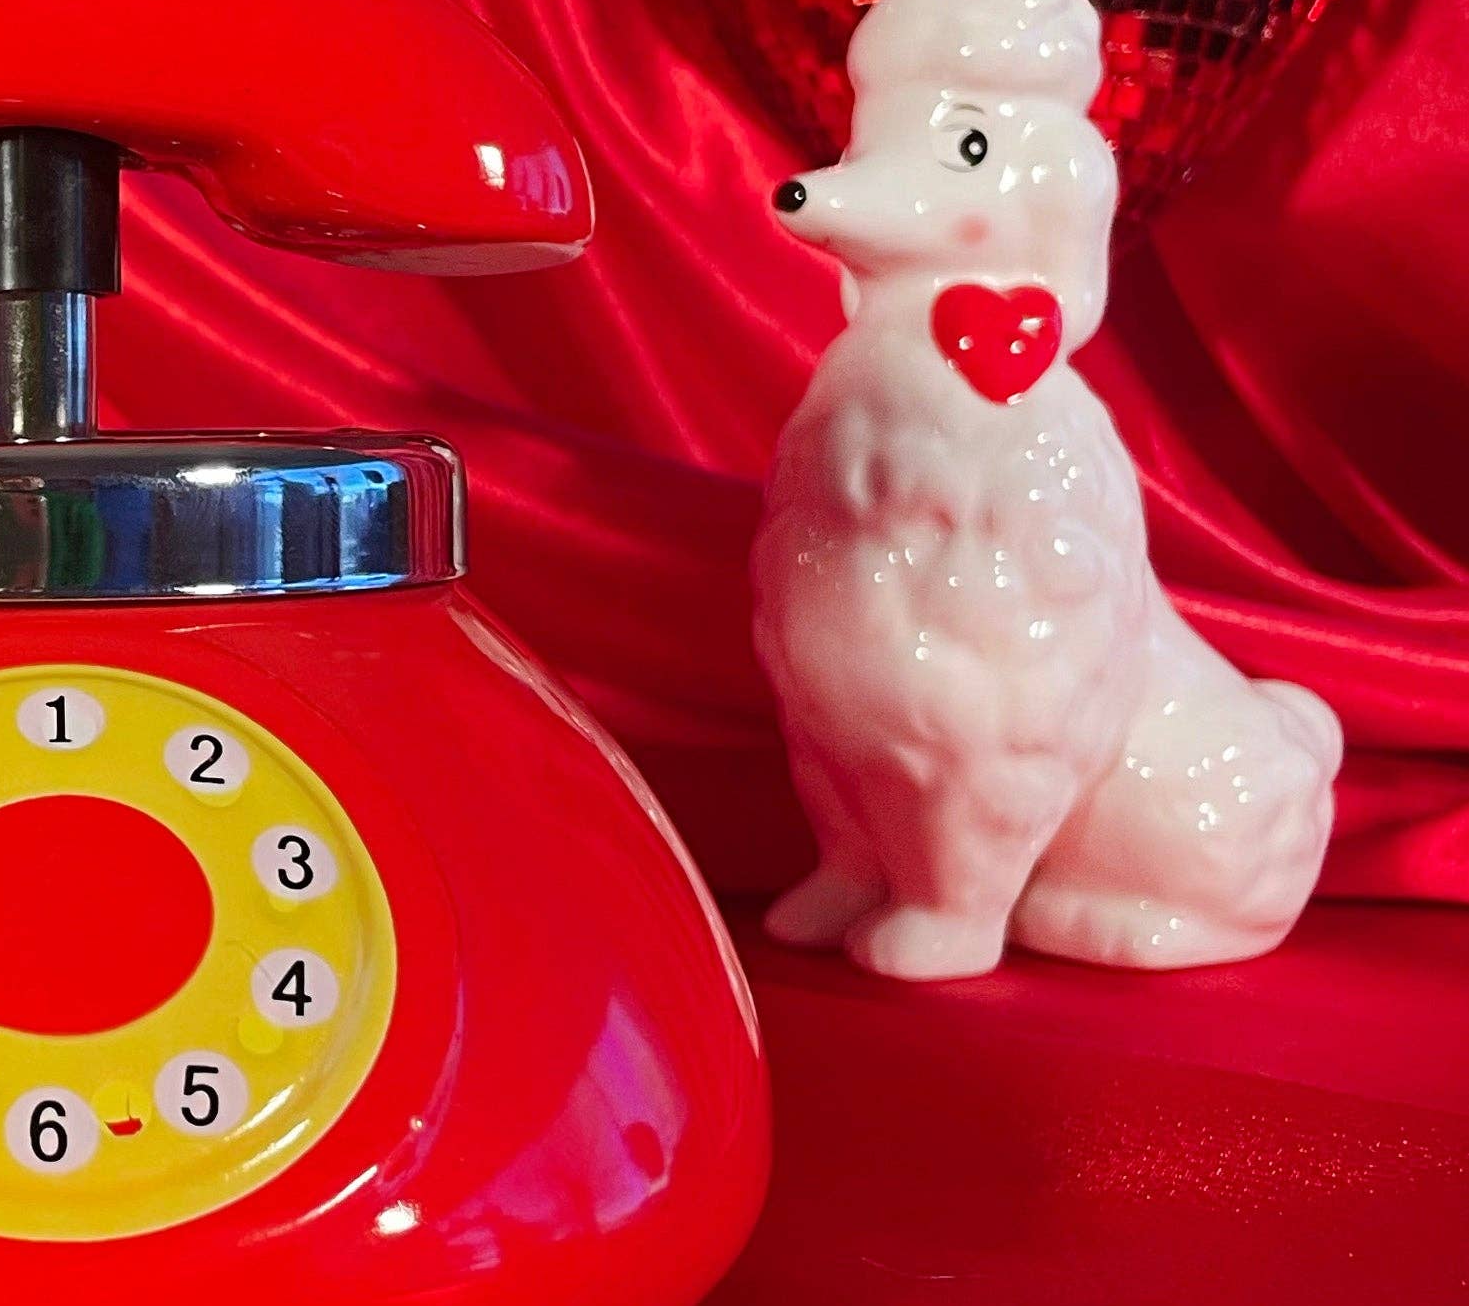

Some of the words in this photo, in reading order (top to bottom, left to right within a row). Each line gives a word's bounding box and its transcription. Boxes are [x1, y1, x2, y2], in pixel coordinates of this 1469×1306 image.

[44, 695, 73, 743] 1
[188, 733, 227, 786] 2
[276, 834, 315, 891] 3
[270, 959, 314, 1018] 4
[180, 1063, 221, 1128] 5
[28, 1098, 69, 1164] 6
